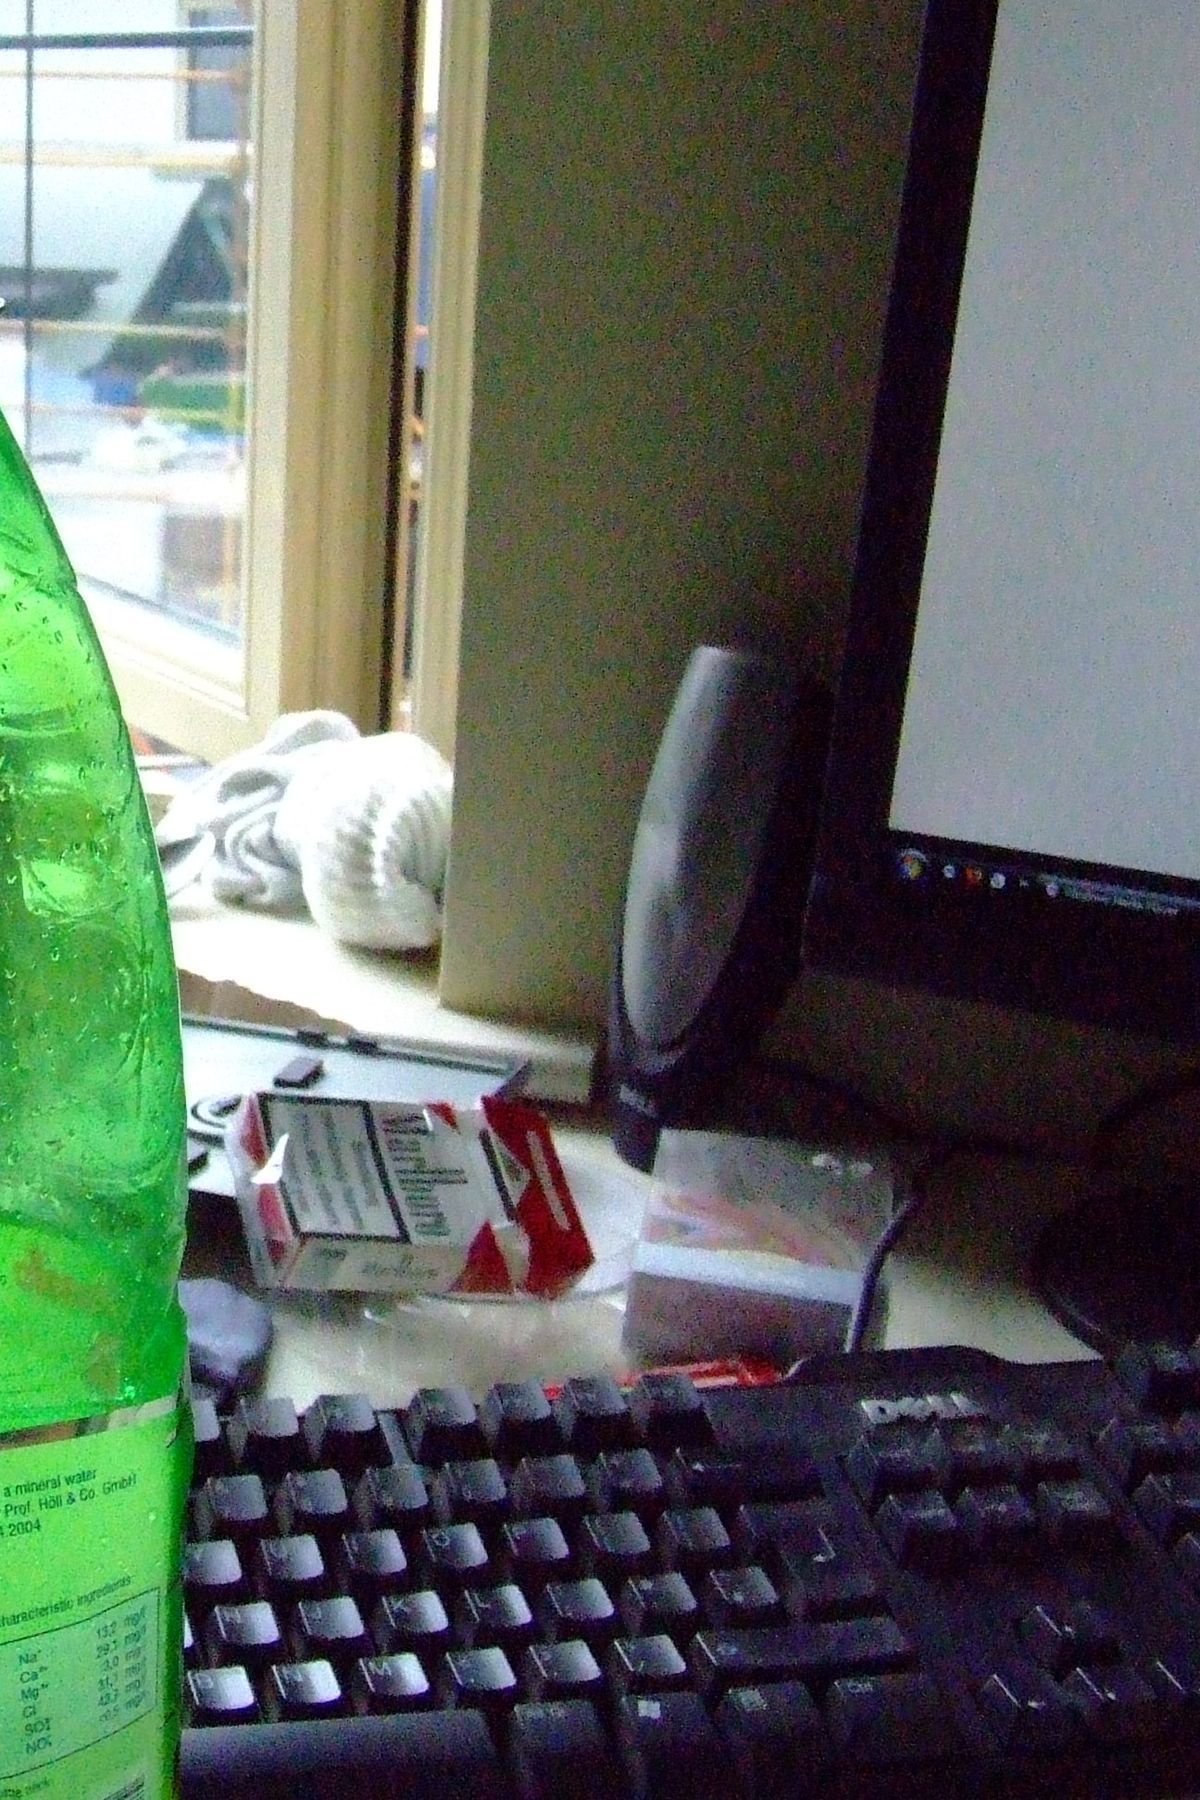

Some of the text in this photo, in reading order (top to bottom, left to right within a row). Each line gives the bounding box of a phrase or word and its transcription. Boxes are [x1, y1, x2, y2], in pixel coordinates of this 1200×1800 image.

[3, 1486, 12, 1498] a
[14, 1474, 62, 1496] mineral
[64, 1468, 98, 1486] water
[66, 1492, 76, 1505] &
